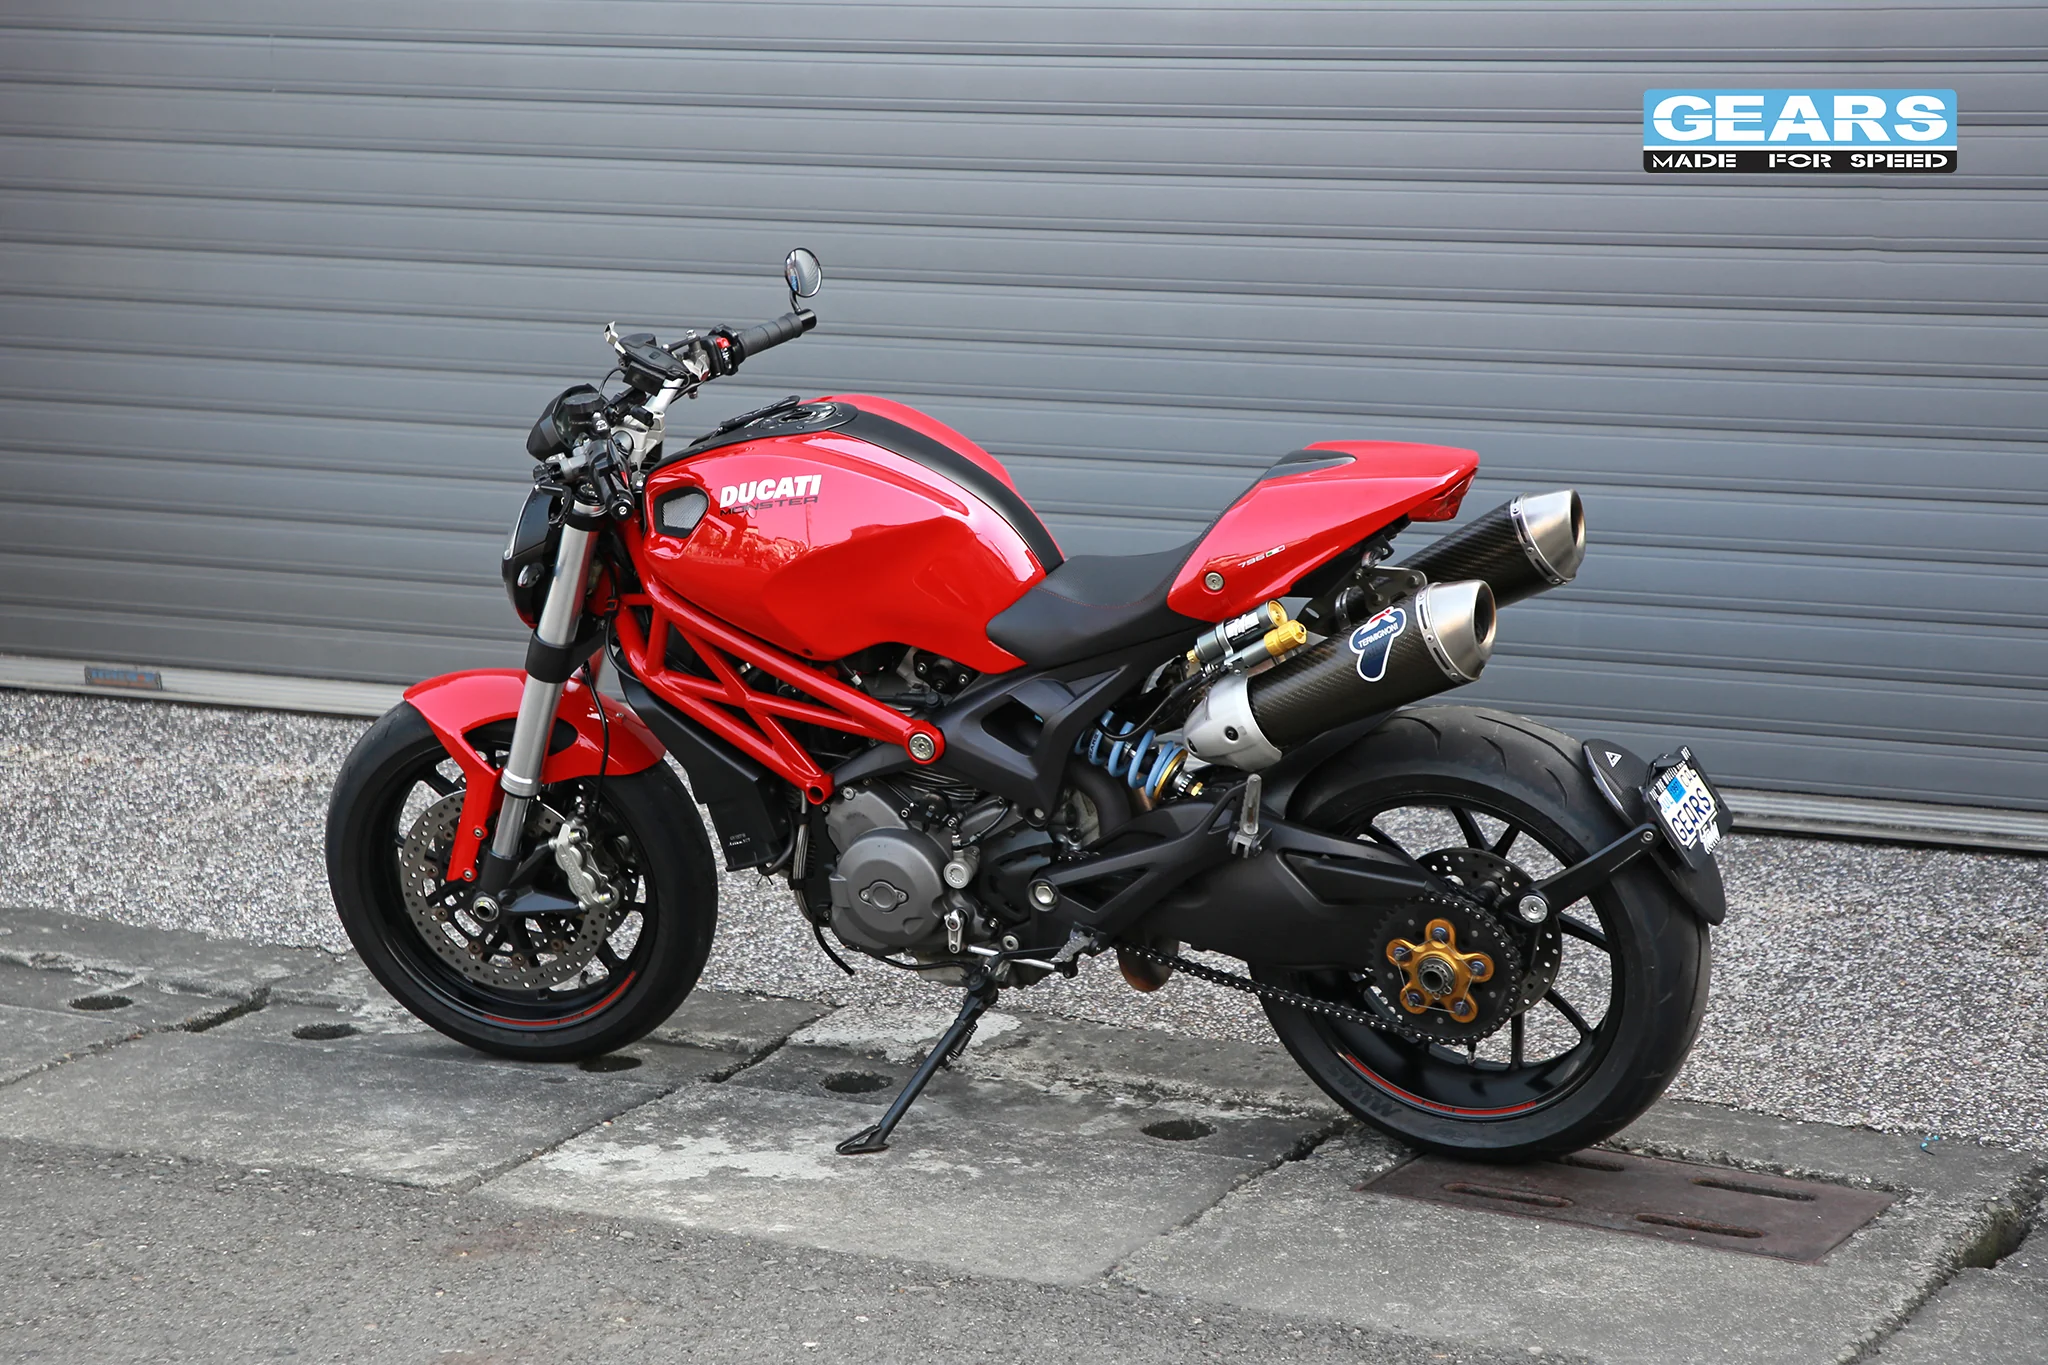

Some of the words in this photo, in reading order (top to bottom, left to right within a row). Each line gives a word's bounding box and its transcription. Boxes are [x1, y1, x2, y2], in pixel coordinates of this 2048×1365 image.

[720, 474, 822, 508] DUCATI
[720, 496, 818, 516] MONSTER
[1357, 622, 1399, 648] TERMIGNONI
[1671, 787, 1711, 842] GEARS
